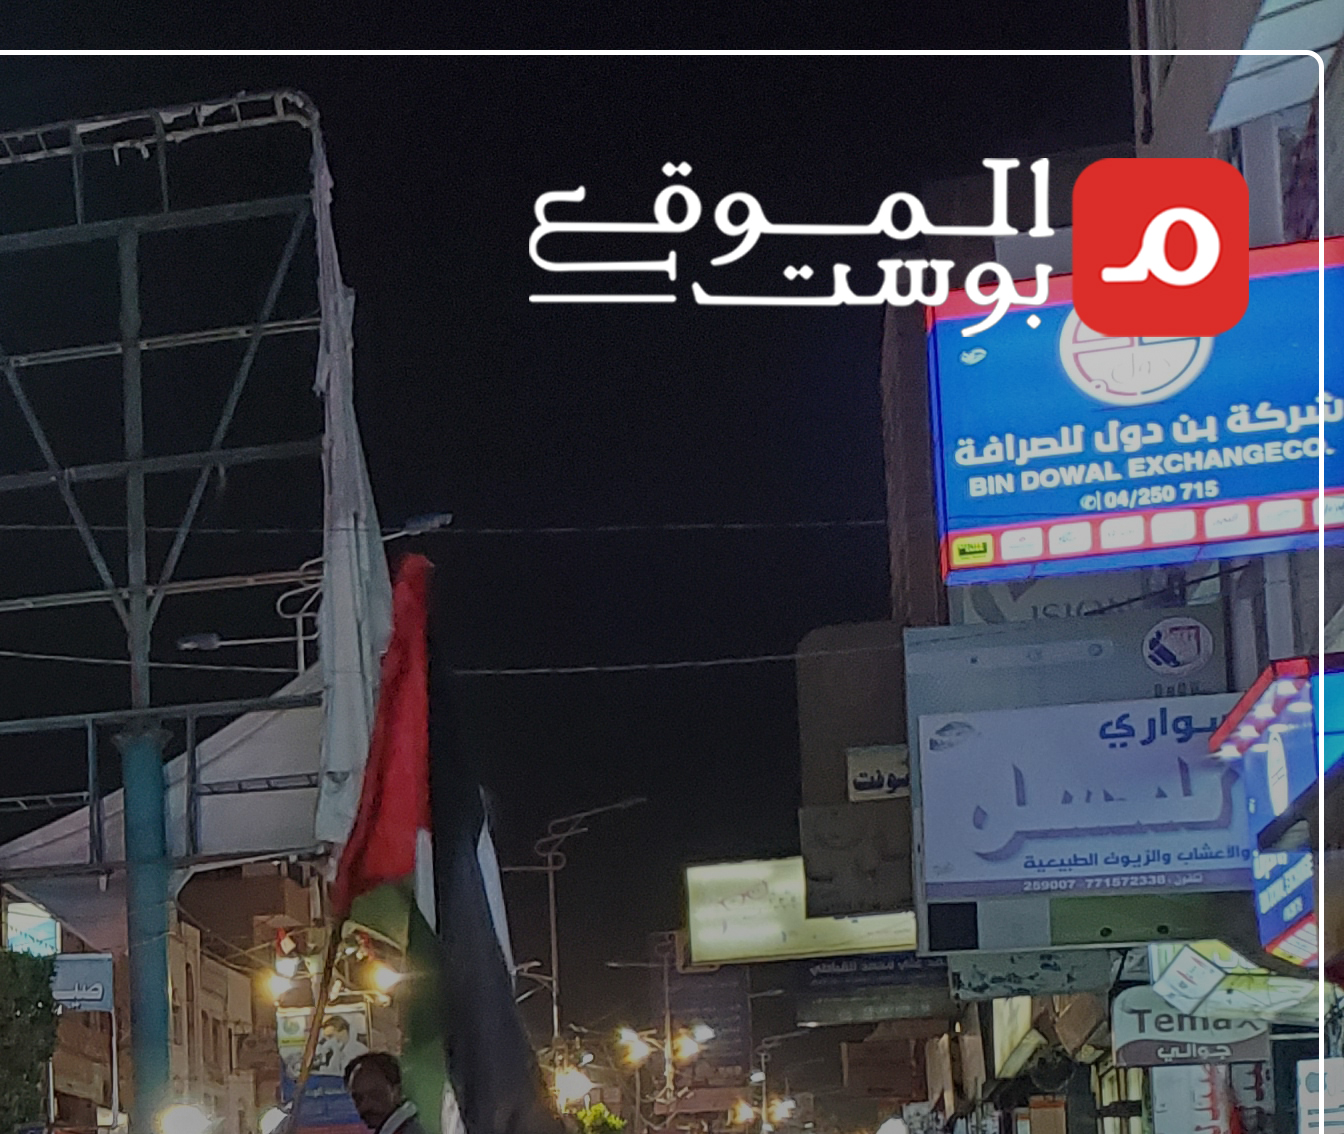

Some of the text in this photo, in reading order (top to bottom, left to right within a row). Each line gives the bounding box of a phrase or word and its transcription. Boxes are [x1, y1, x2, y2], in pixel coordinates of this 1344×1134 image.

[1093, 420, 1164, 453] دول
[1172, 414, 1218, 443] بن
[954, 424, 1085, 467] للصرافة
[968, 472, 1014, 497] BIN
[1020, 460, 1122, 491] DOWAL
[1104, 479, 1219, 509] 04/250 715
[1023, 853, 1098, 873] الطبيعية
[1157, 1043, 1233, 1062] جوالي
